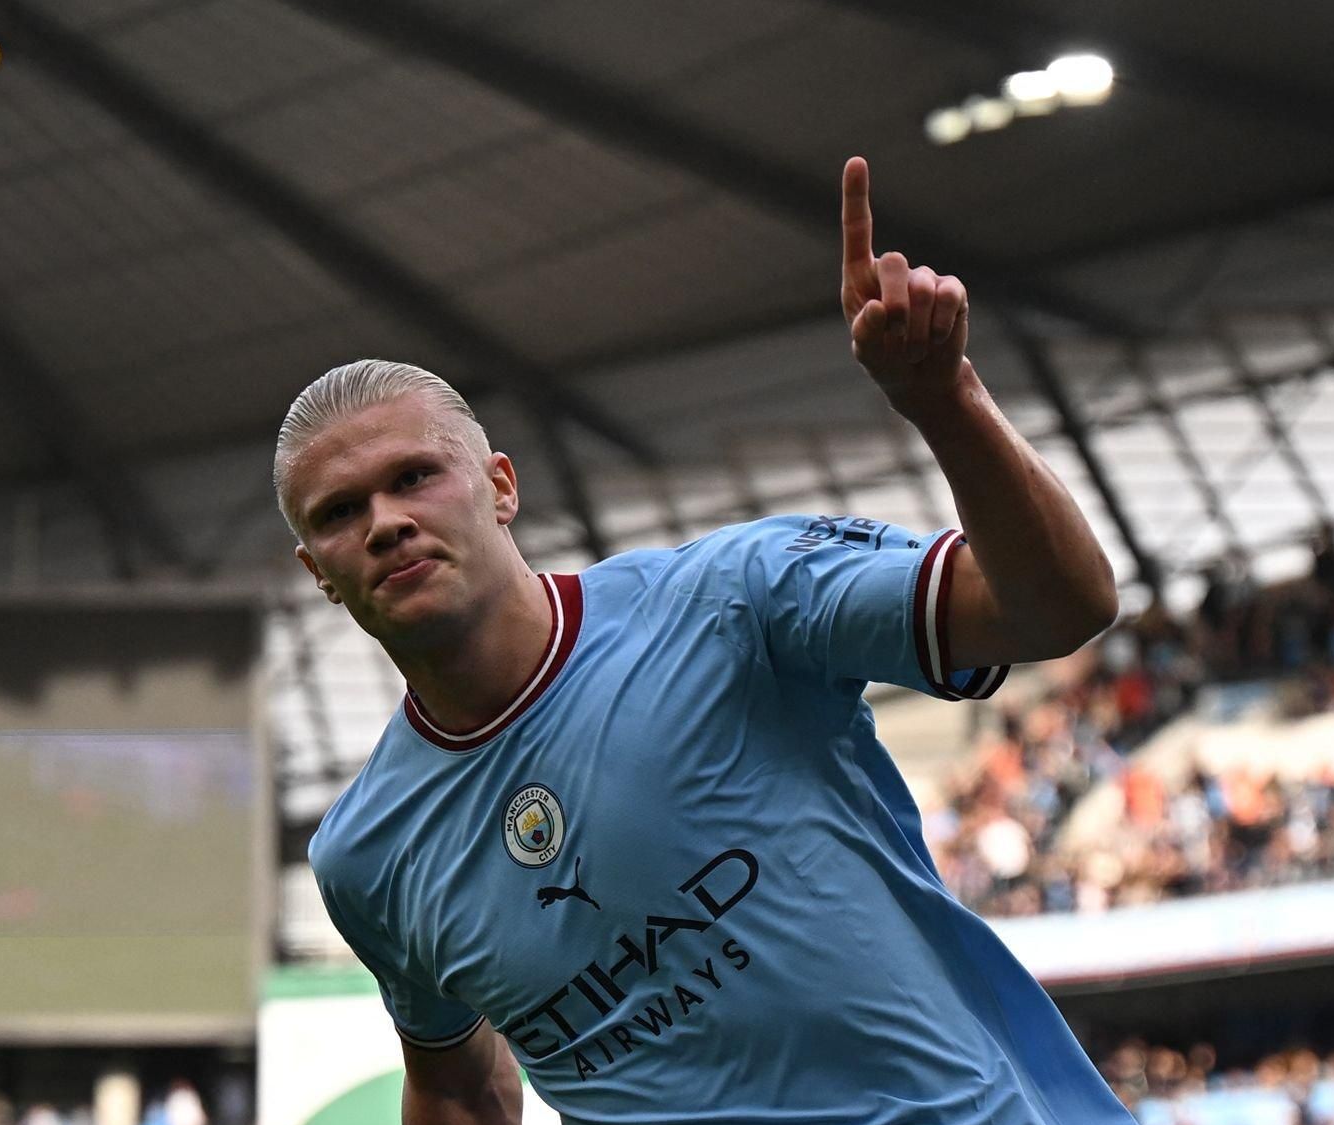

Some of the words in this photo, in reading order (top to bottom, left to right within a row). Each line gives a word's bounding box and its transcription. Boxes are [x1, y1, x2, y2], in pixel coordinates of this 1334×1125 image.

[507, 790, 549, 831] MANCHESTER
[538, 844, 557, 862] CITY
[500, 848, 759, 1060] ETIHAD
[572, 938, 751, 1082] AIRWAYS
